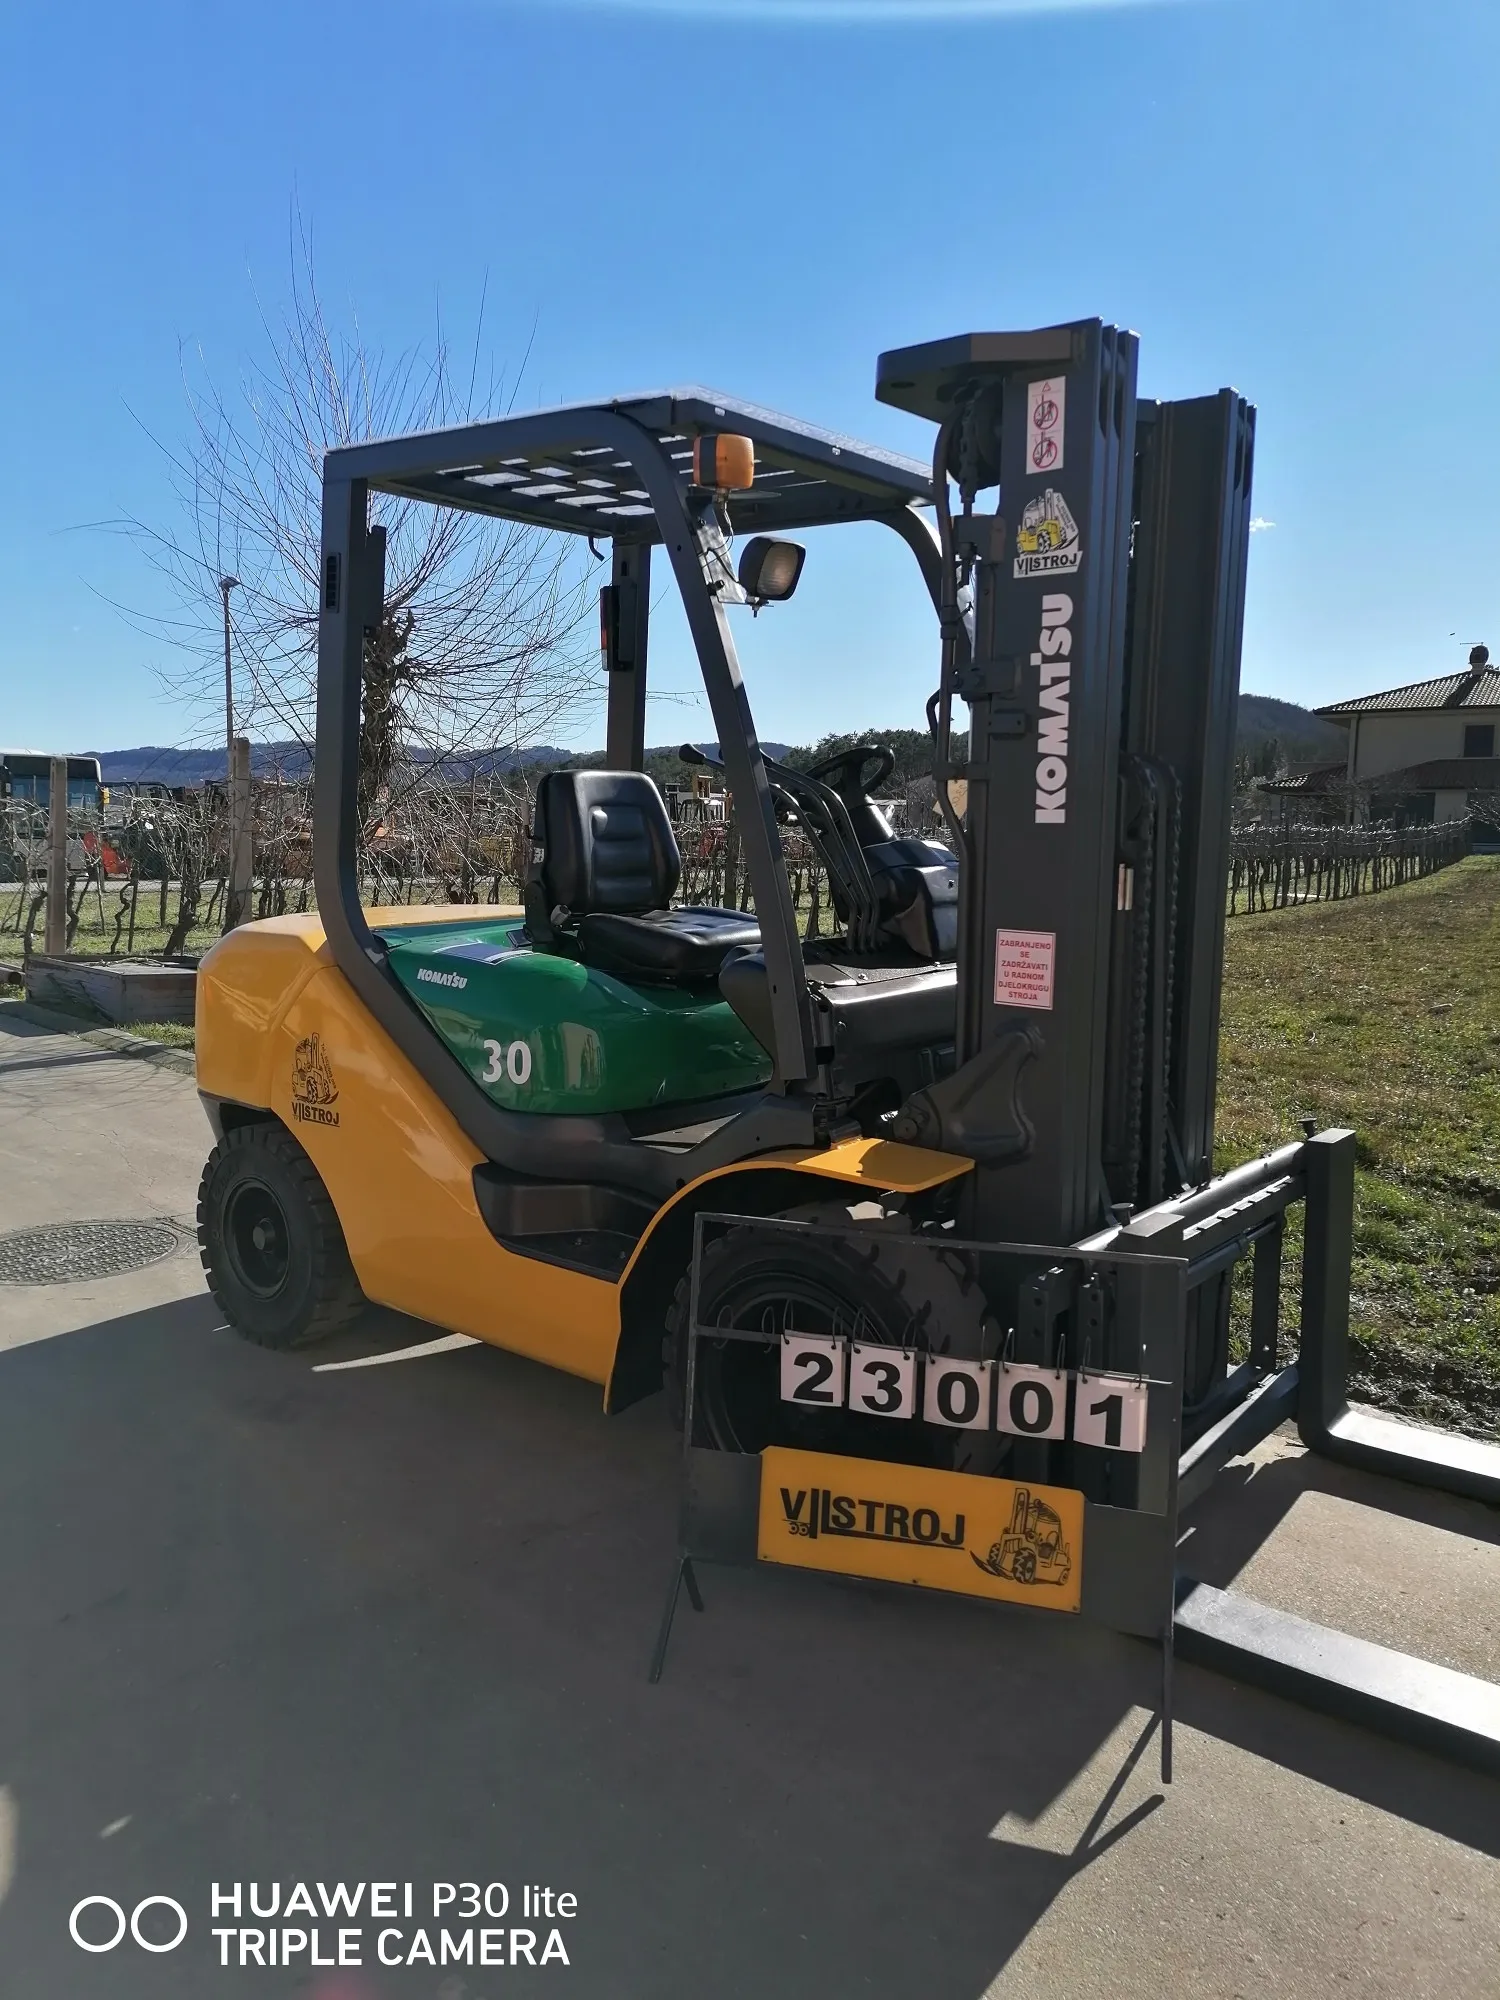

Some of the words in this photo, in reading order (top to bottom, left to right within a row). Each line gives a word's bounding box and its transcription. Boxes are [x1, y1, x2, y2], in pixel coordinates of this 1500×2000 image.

[1030, 593, 1074, 824] KOMATSU
[1000, 939, 1051, 950] ZABRANJENO
[1001, 960, 1048, 970] ZADRŽAVATI
[417, 968, 468, 989] KOMATSU
[1012, 972, 1044, 980] RADNOM
[998, 981, 1049, 992] DJELOKRUGU
[1008, 991, 1037, 1000] STROJA
[482, 1039, 532, 1084] 30
[792, 1352, 1123, 1447] 23001
